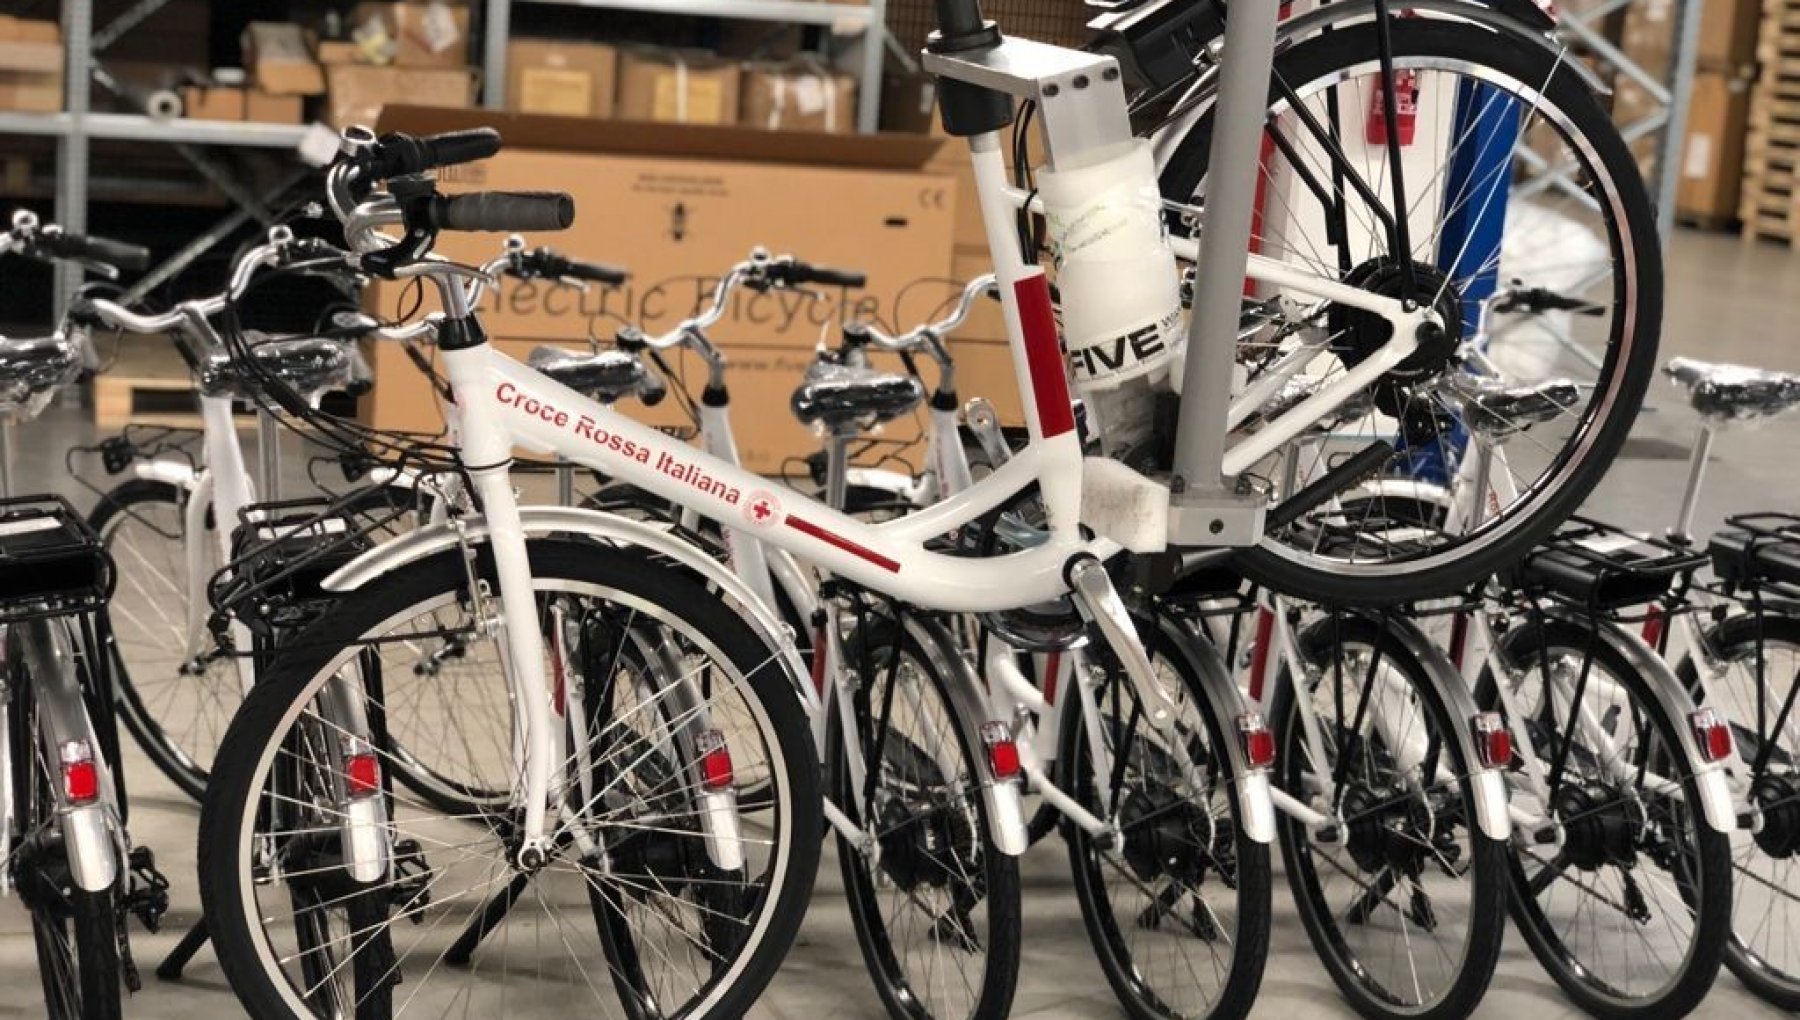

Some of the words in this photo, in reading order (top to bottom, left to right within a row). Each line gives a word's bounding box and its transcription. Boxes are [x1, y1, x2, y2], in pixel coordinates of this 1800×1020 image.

[1068, 323, 1165, 378] FIVE
[496, 382, 569, 428] Croce
[573, 412, 651, 465] Rossa
[655, 450, 741, 505] Italiana
